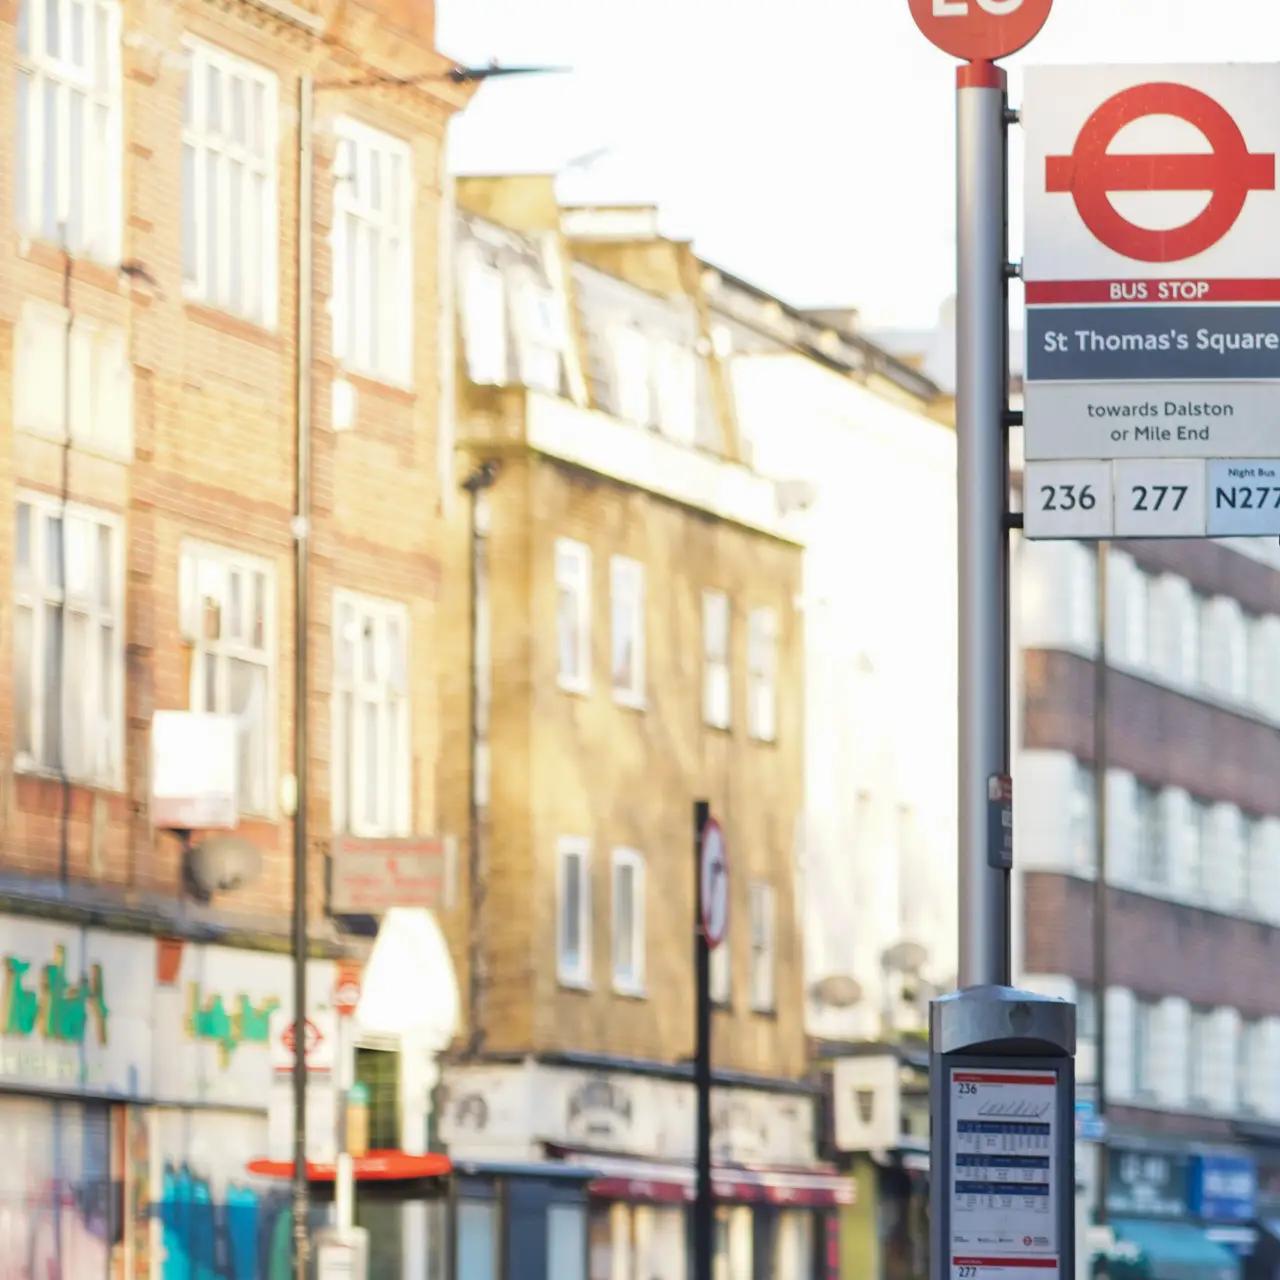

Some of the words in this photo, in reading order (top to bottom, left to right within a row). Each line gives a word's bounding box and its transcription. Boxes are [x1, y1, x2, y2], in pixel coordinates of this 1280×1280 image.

[1109, 282, 1148, 300] BUS
[1157, 281, 1210, 299] STOP
[1043, 331, 1068, 352] St
[1074, 329, 1189, 352] Thomas's
[1196, 328, 1280, 354] Square
[1087, 402, 1159, 418] towards
[1164, 401, 1234, 417] Dalston
[1110, 429, 1130, 442] or
[1134, 426, 1171, 442] Mile
[1177, 425, 1210, 441] End
[1228, 467, 1255, 479] Night
[1257, 467, 1276, 478] Bus
[1040, 484, 1096, 511] 236
[1131, 485, 1189, 511] 277
